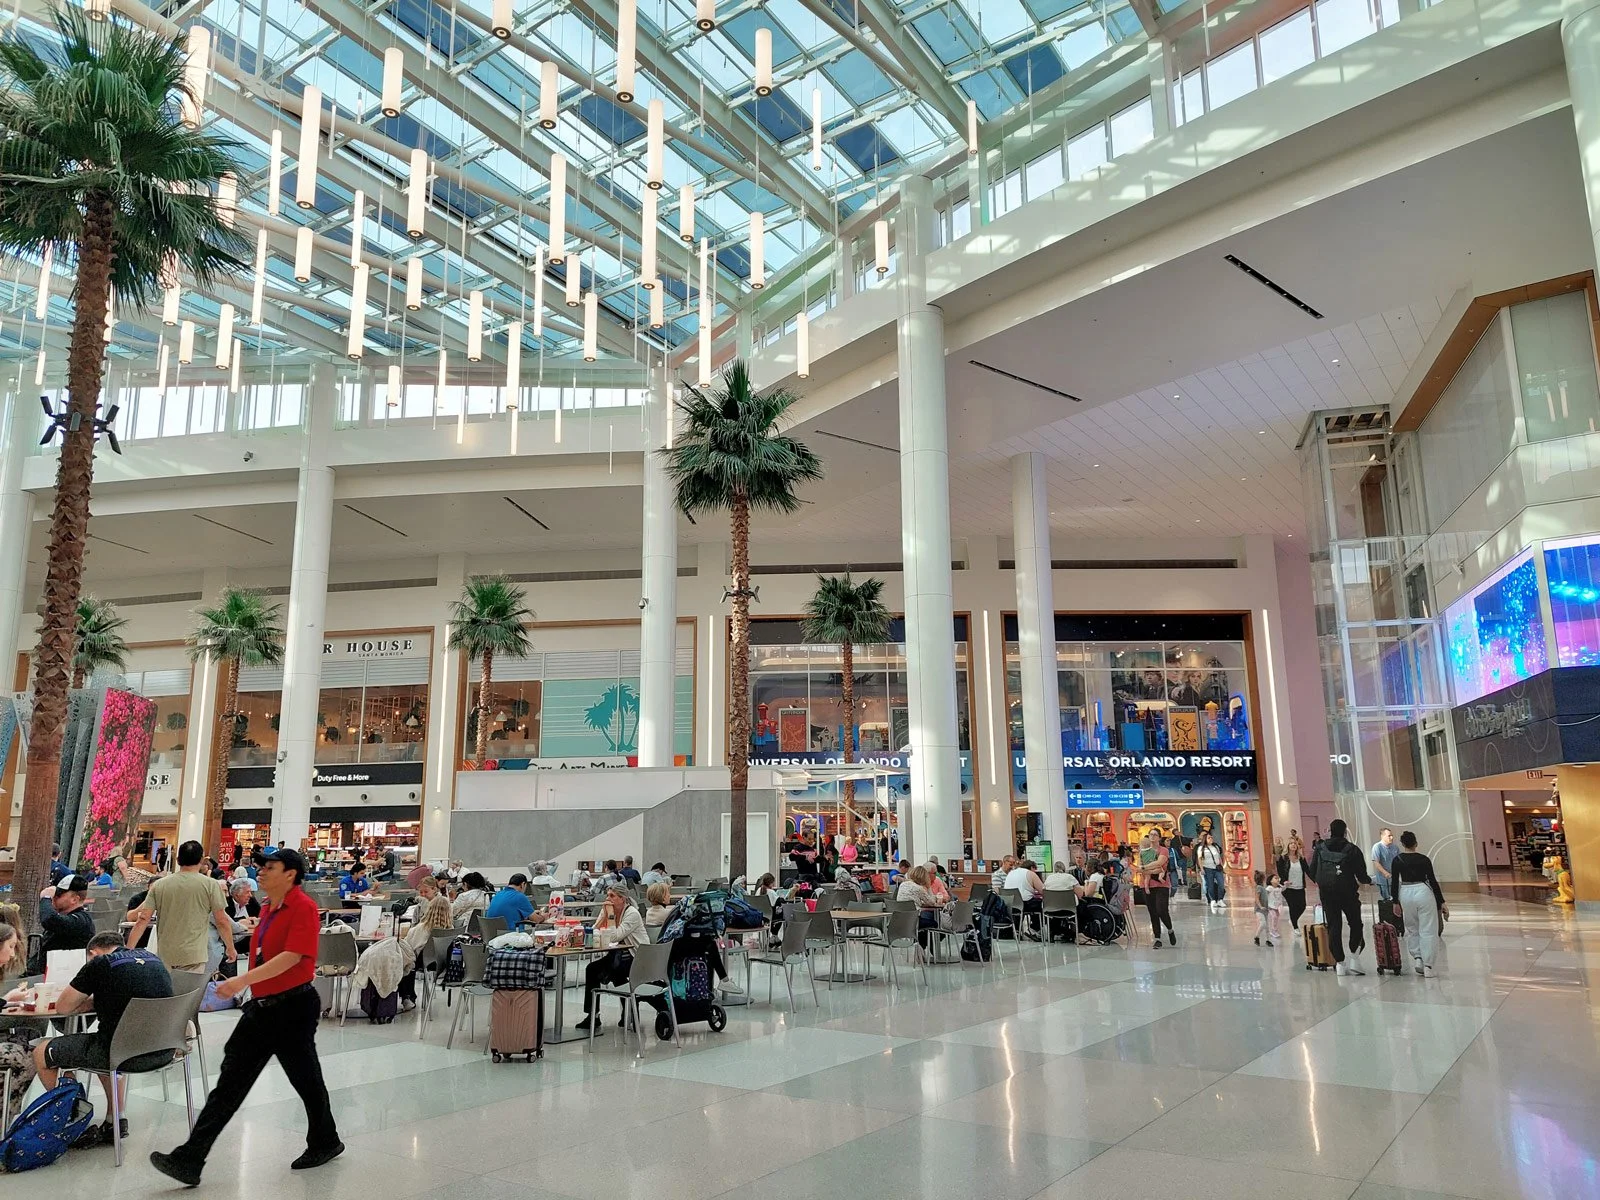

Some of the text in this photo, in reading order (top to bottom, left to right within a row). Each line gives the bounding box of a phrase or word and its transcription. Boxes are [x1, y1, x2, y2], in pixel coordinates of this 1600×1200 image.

[346, 640, 412, 653] HOUSE
[747, 757, 816, 766] NIVERSAL
[825, 757, 902, 768] ORANDO
[1016, 756, 1253, 768] URSAL ORLANDO RESORT
[317, 775, 332, 783] Duty
